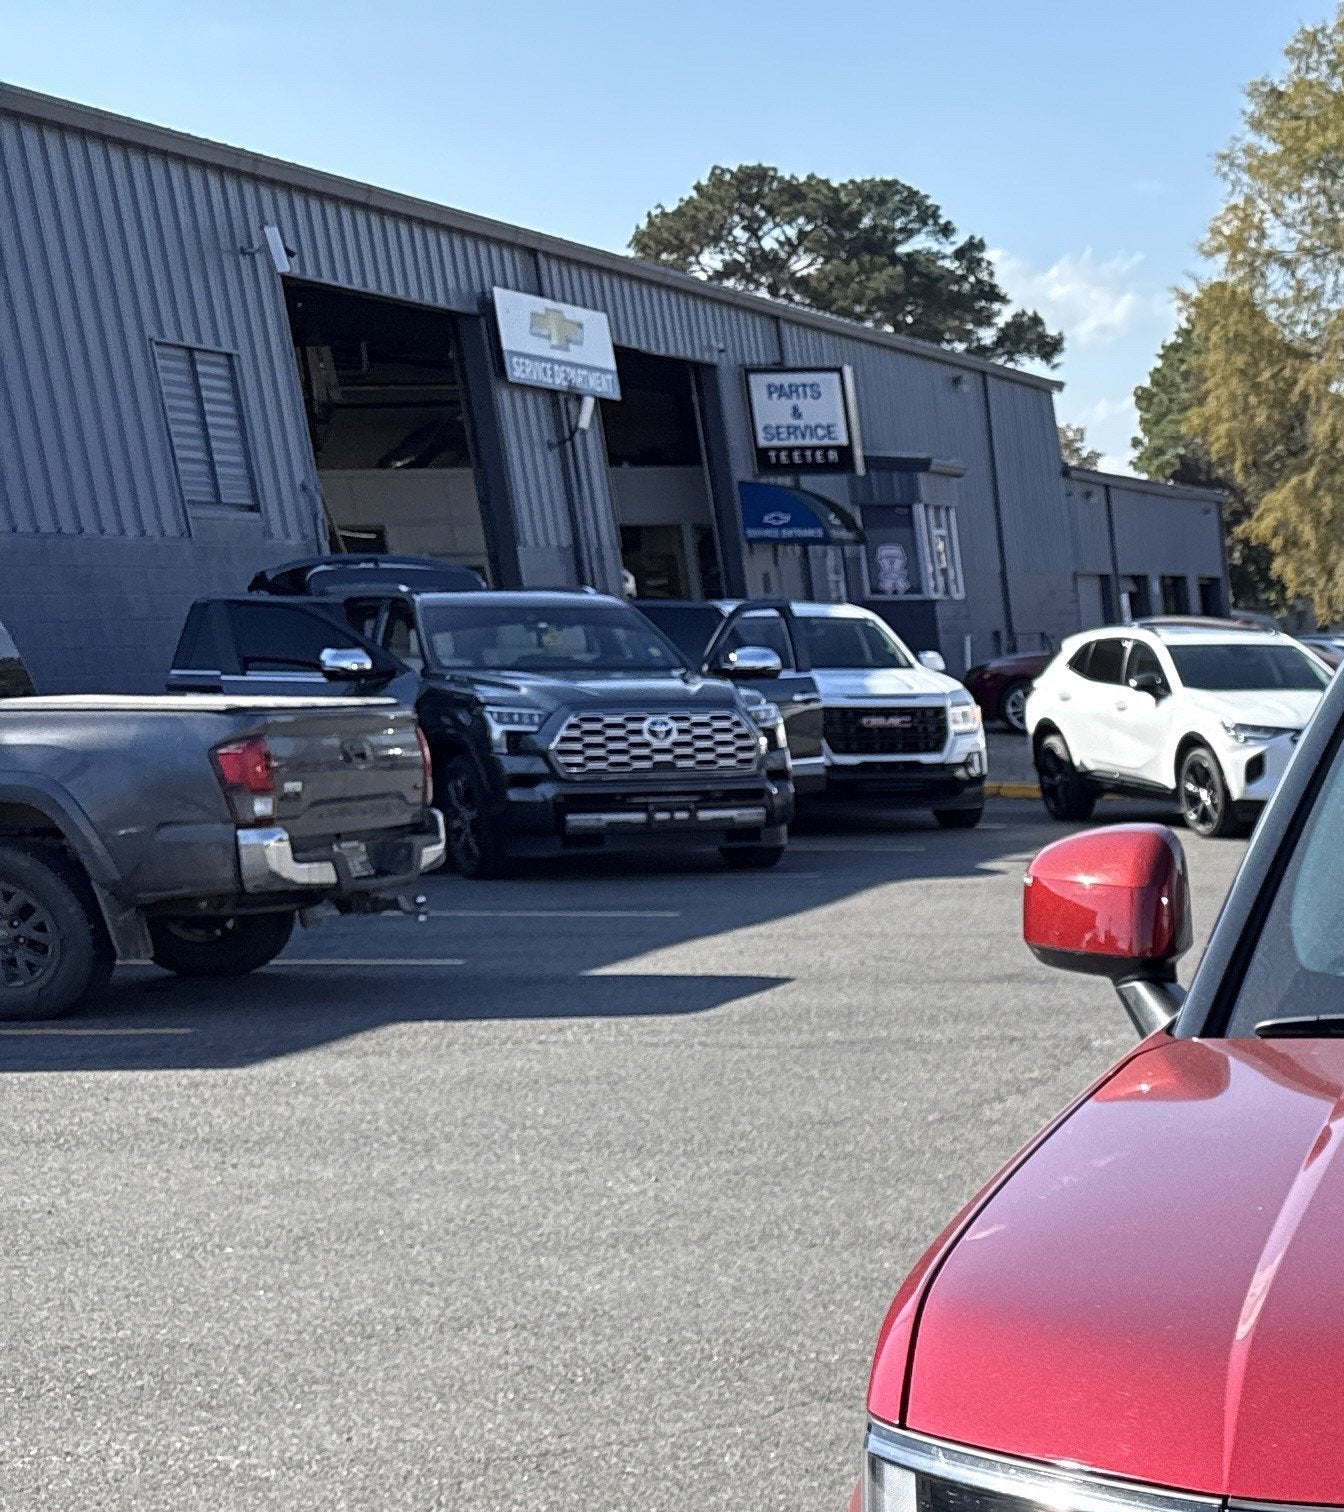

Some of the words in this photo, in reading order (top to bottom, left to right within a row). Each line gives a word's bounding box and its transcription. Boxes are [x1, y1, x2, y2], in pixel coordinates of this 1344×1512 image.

[512, 357, 554, 384] SERVICE
[766, 383, 822, 400] PARTS
[791, 404, 803, 420] &
[762, 424, 839, 441] SERVICE
[768, 449, 839, 465] TEETER
